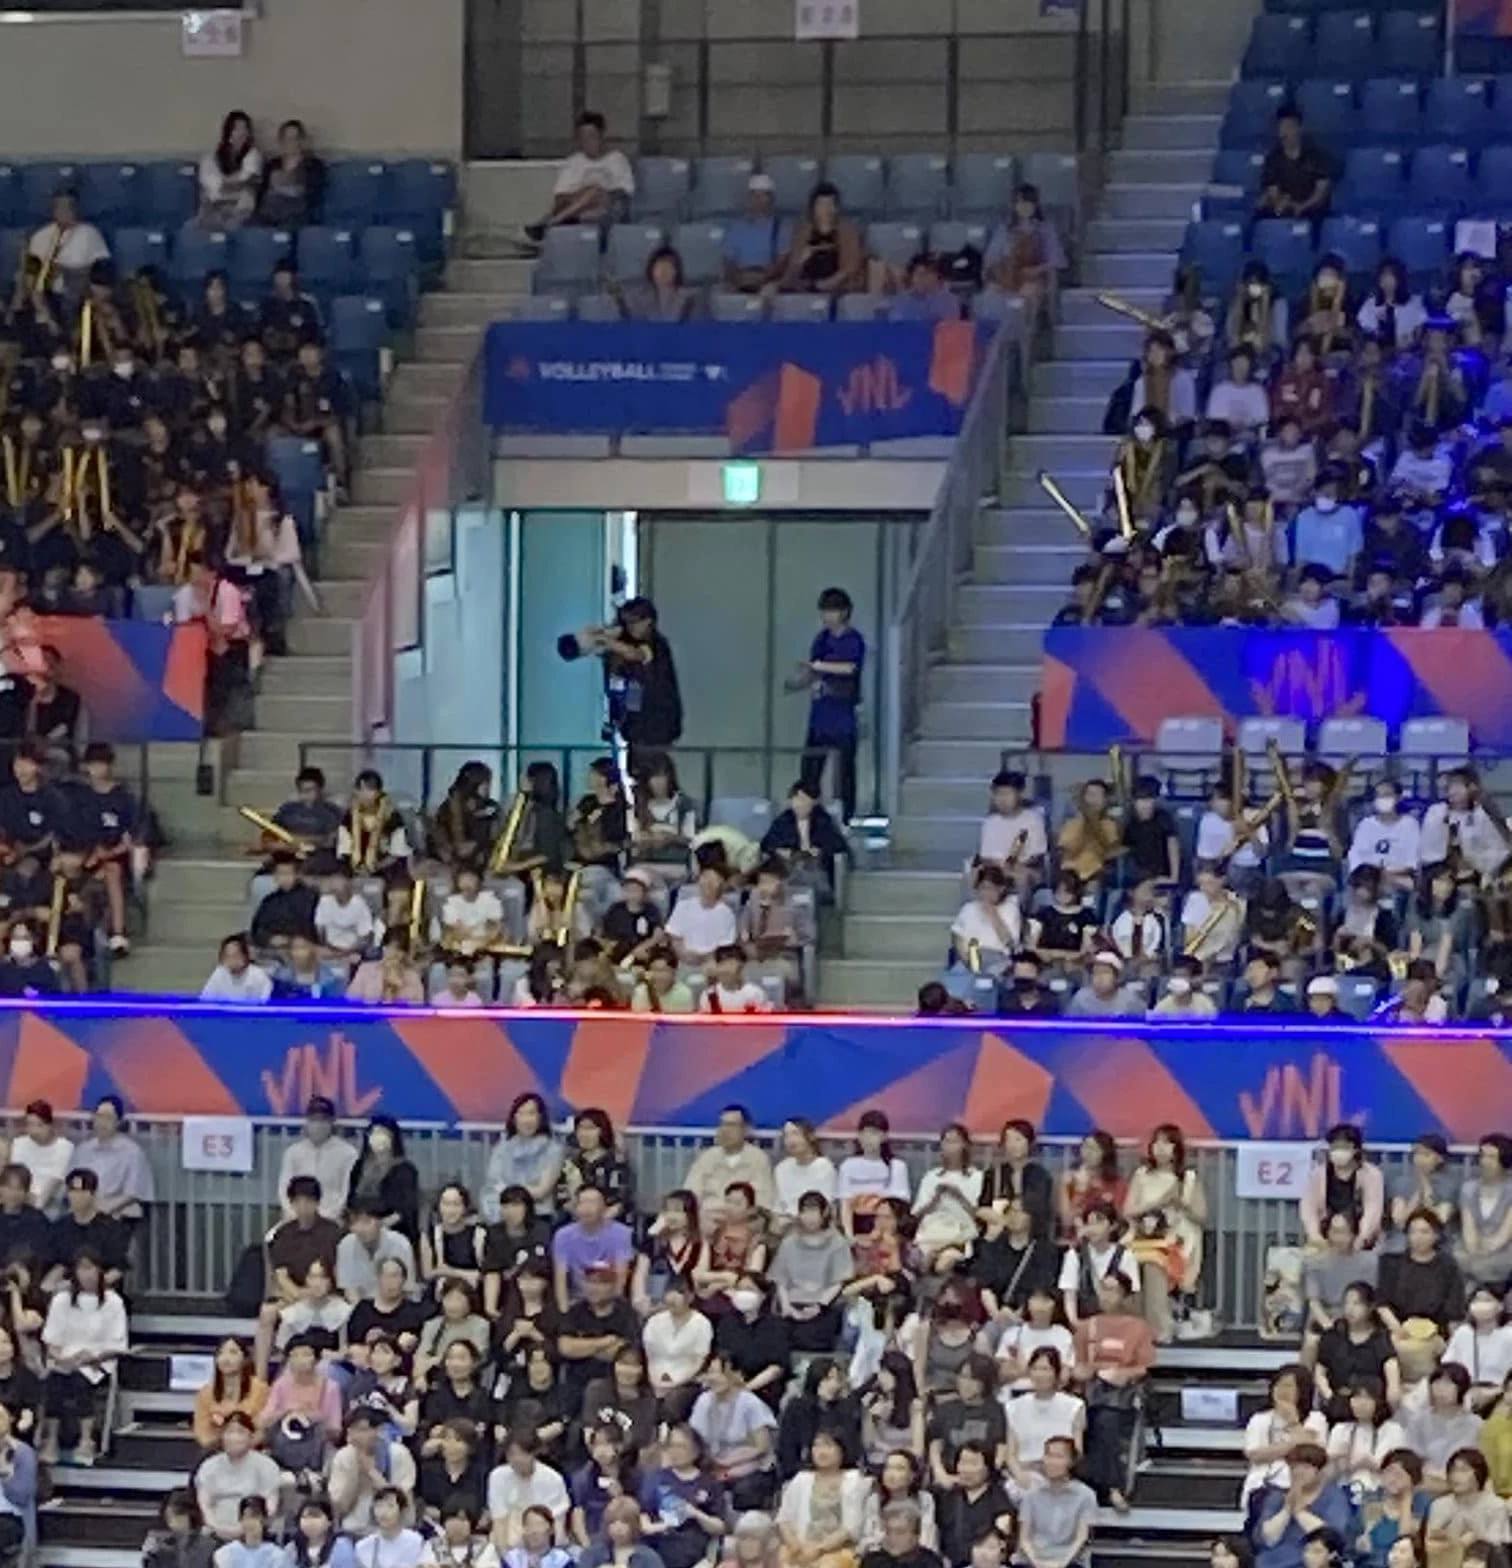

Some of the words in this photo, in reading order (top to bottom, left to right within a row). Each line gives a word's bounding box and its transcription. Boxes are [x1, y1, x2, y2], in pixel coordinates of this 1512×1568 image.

[260, 1030, 383, 1118] VNL
[1240, 1053, 1368, 1140] VNL
[202, 1135, 234, 1158] E3
[1257, 1160, 1293, 1186] E2
